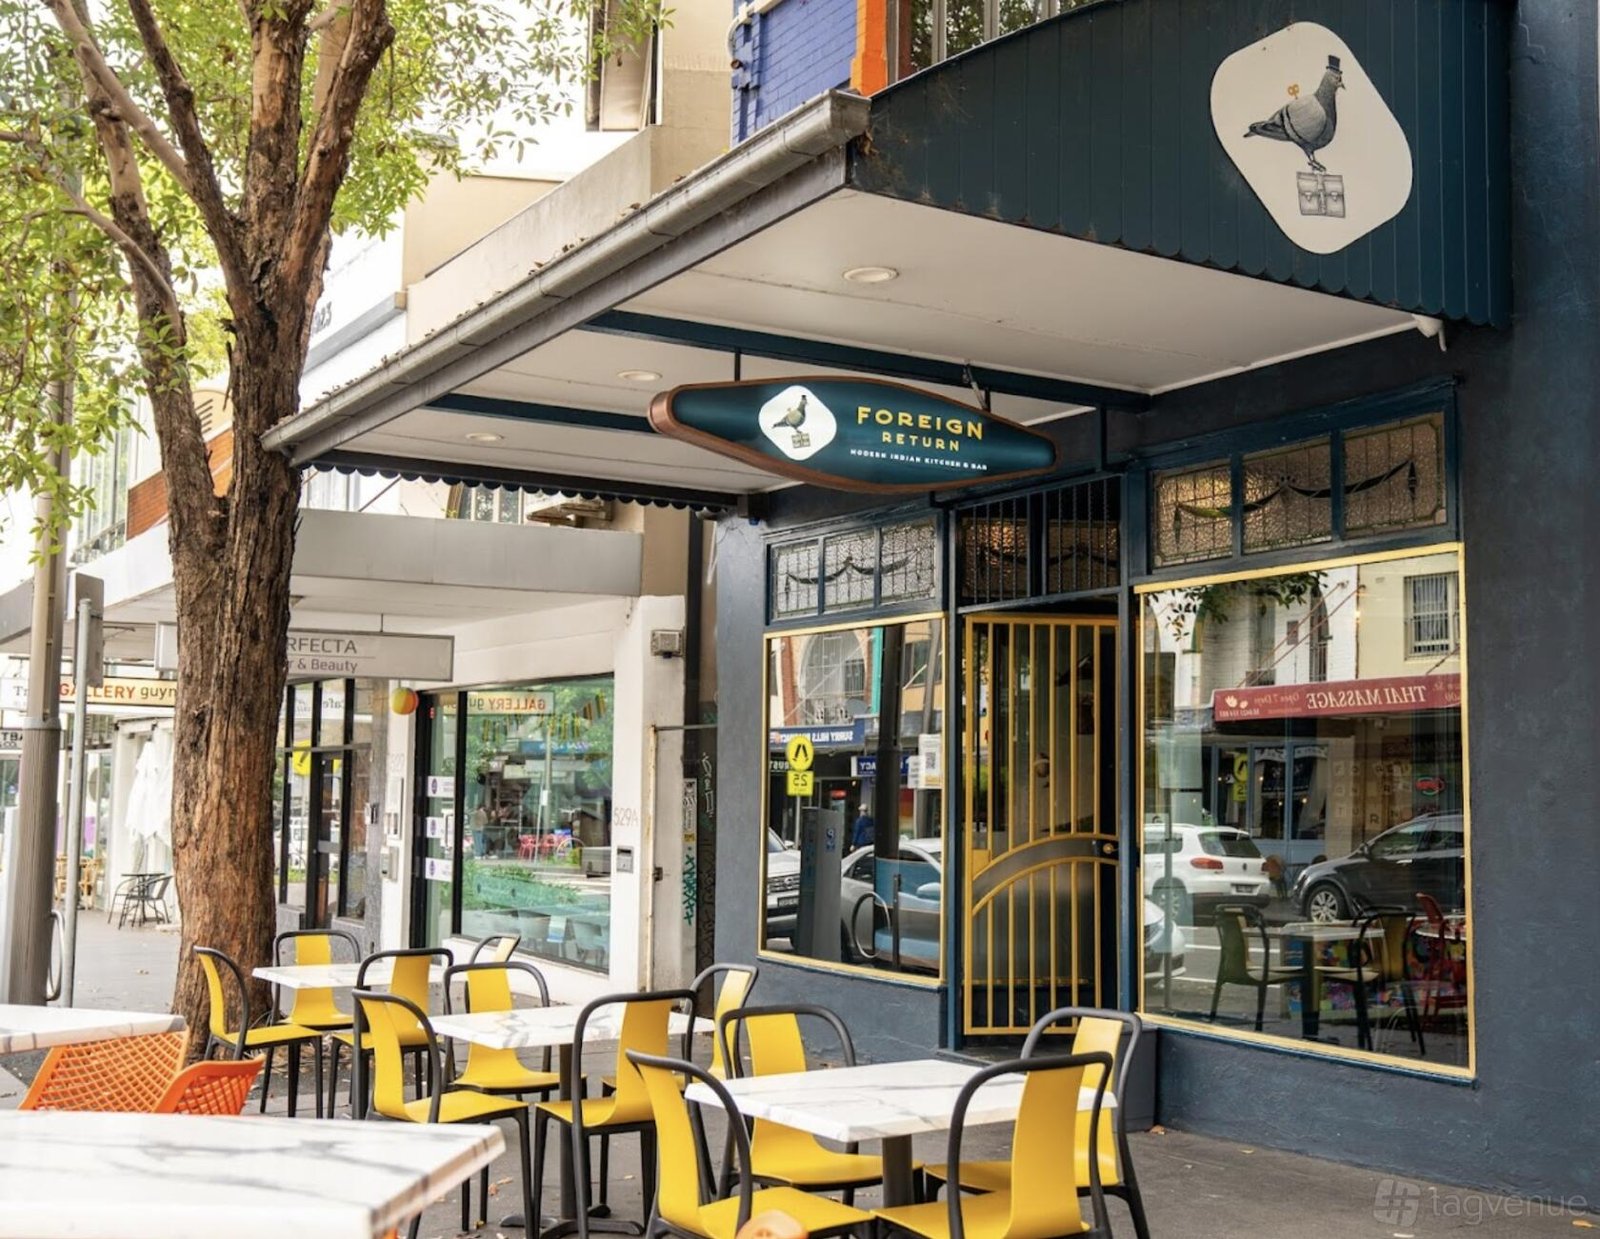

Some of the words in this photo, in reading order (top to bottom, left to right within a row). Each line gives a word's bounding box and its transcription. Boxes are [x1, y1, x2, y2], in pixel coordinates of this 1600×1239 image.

[857, 405, 984, 440] FOREIGN
[882, 431, 960, 452] RETURN
[850, 448, 887, 459] MODERN
[890, 452, 921, 463] INDIAN
[924, 457, 961, 468] KITCHEN
[971, 462, 988, 471] BAR
[297, 657, 306, 670] &
[311, 658, 358, 674] Beauty
